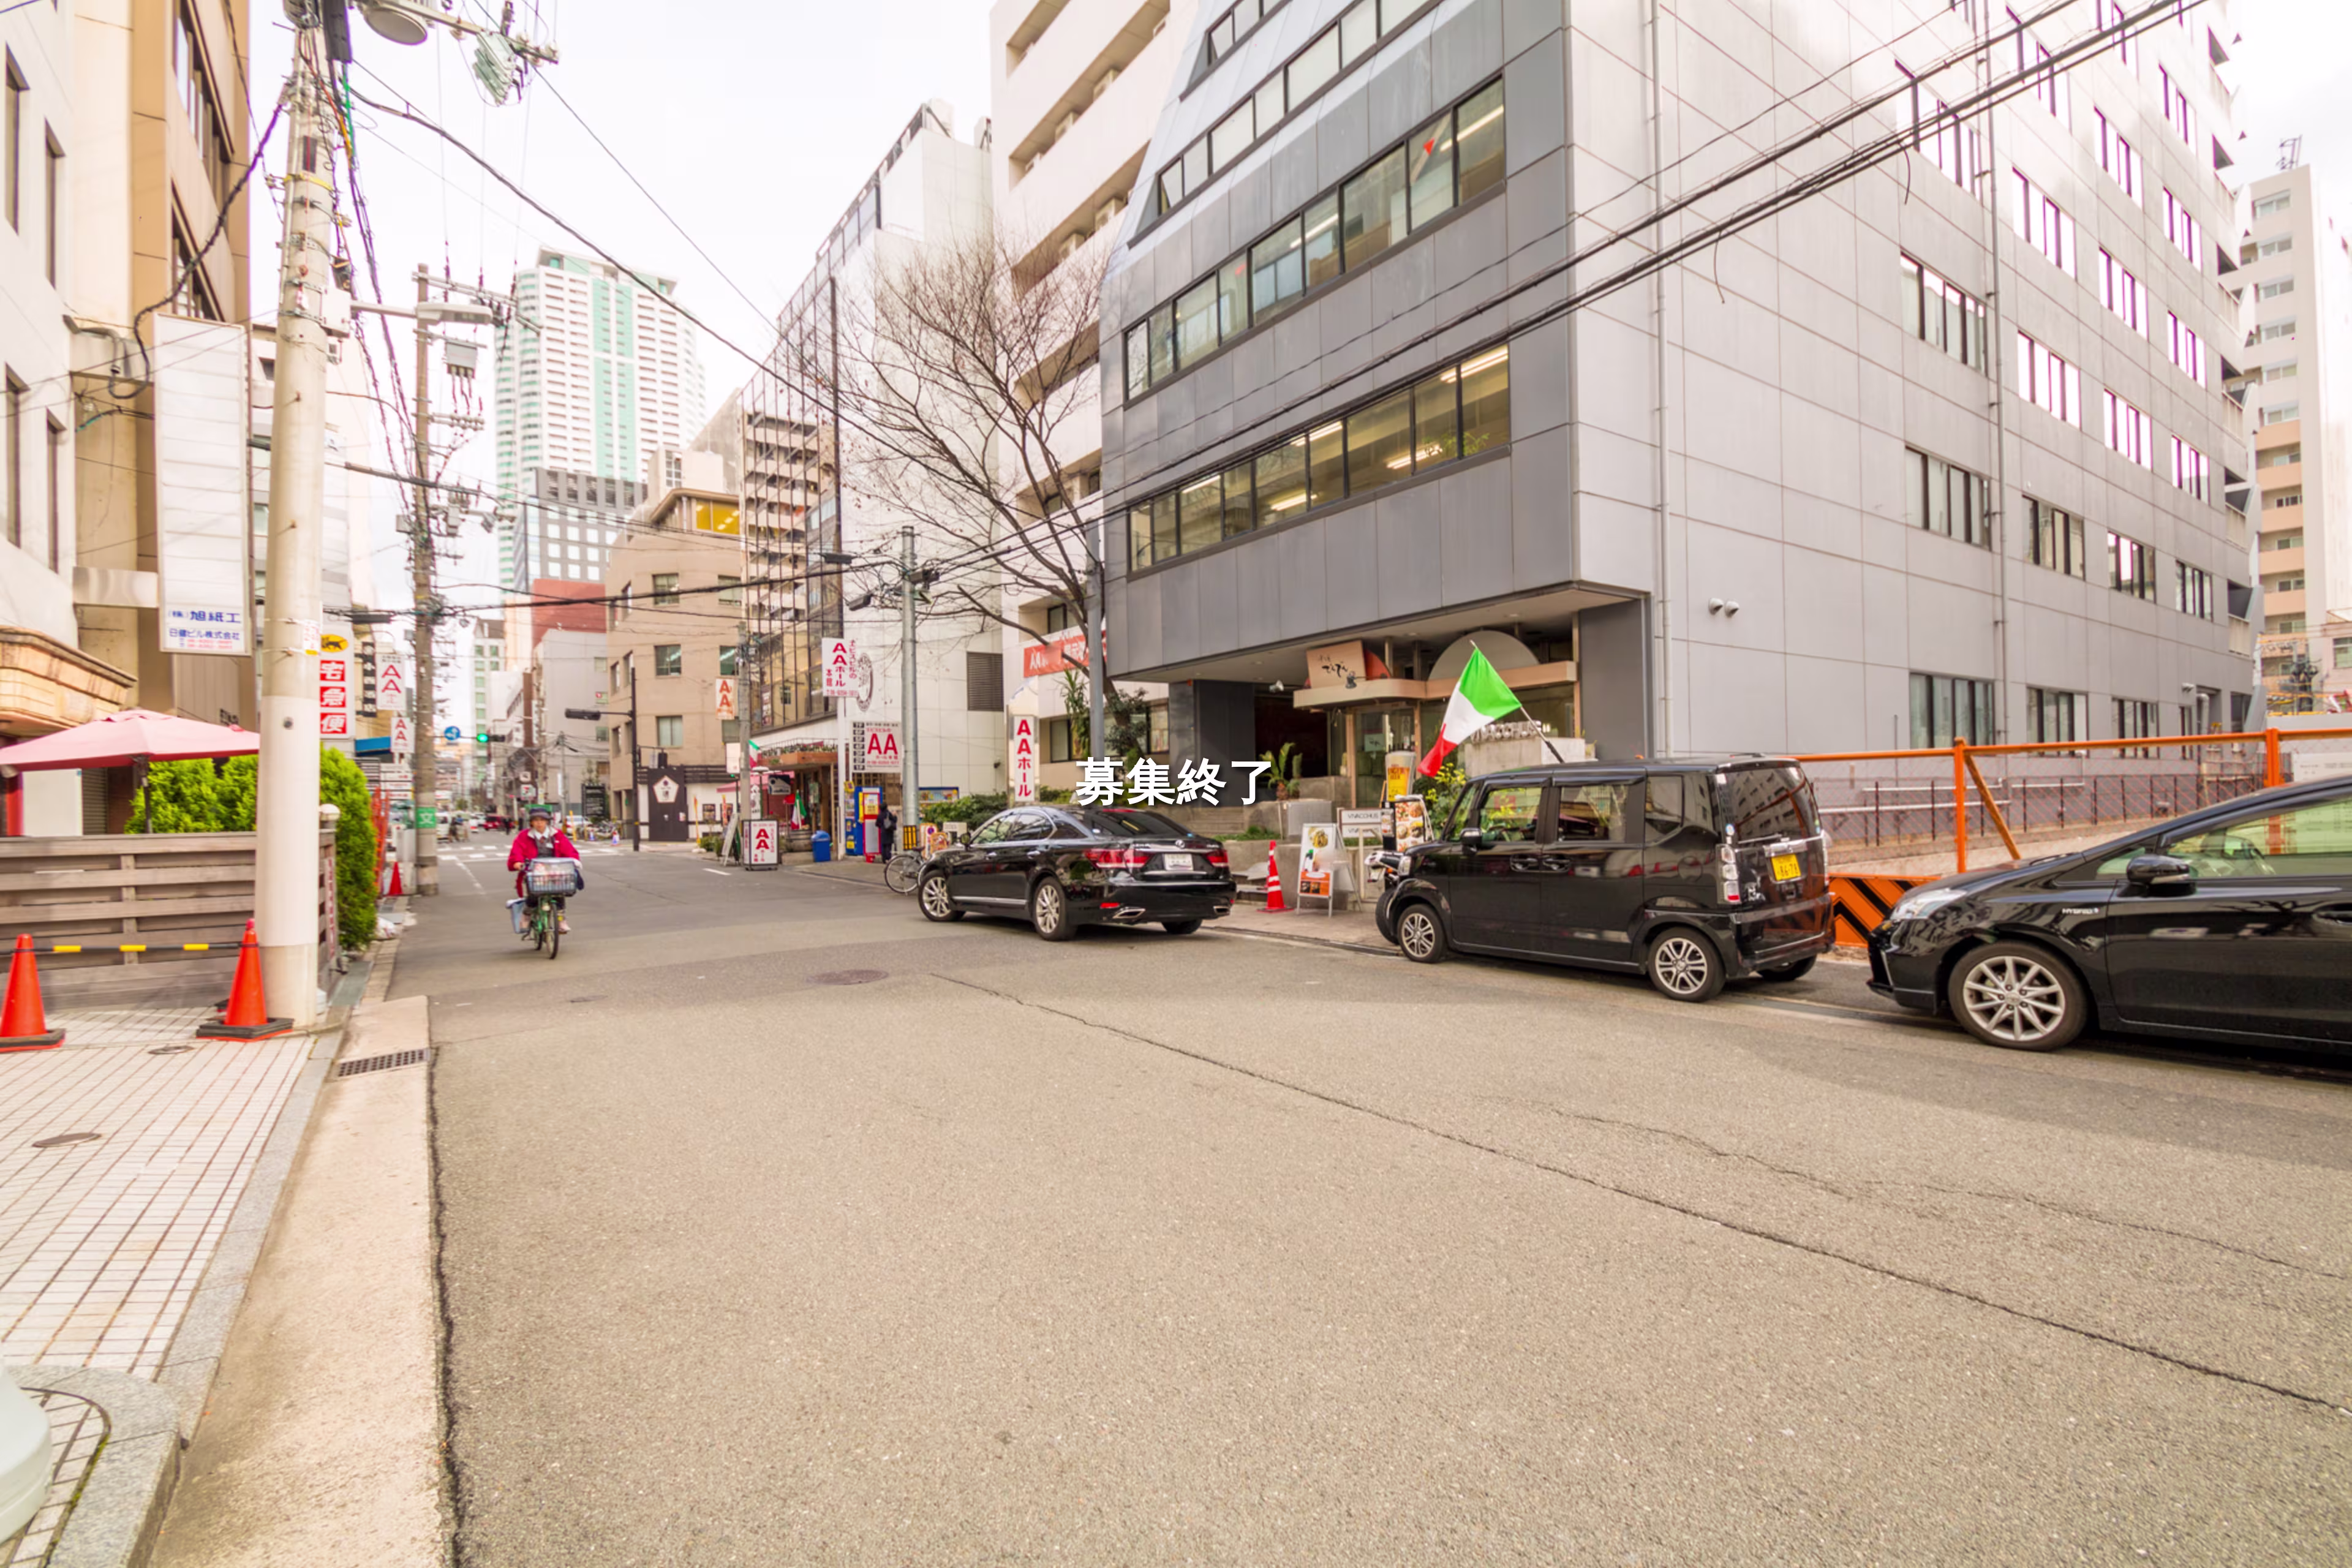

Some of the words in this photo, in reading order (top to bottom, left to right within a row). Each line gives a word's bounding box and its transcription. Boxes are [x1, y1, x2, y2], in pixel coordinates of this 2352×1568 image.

[320, 660, 345, 734] 宅急便
[867, 733, 898, 755] AA
[1017, 719, 1032, 797] AAホール
